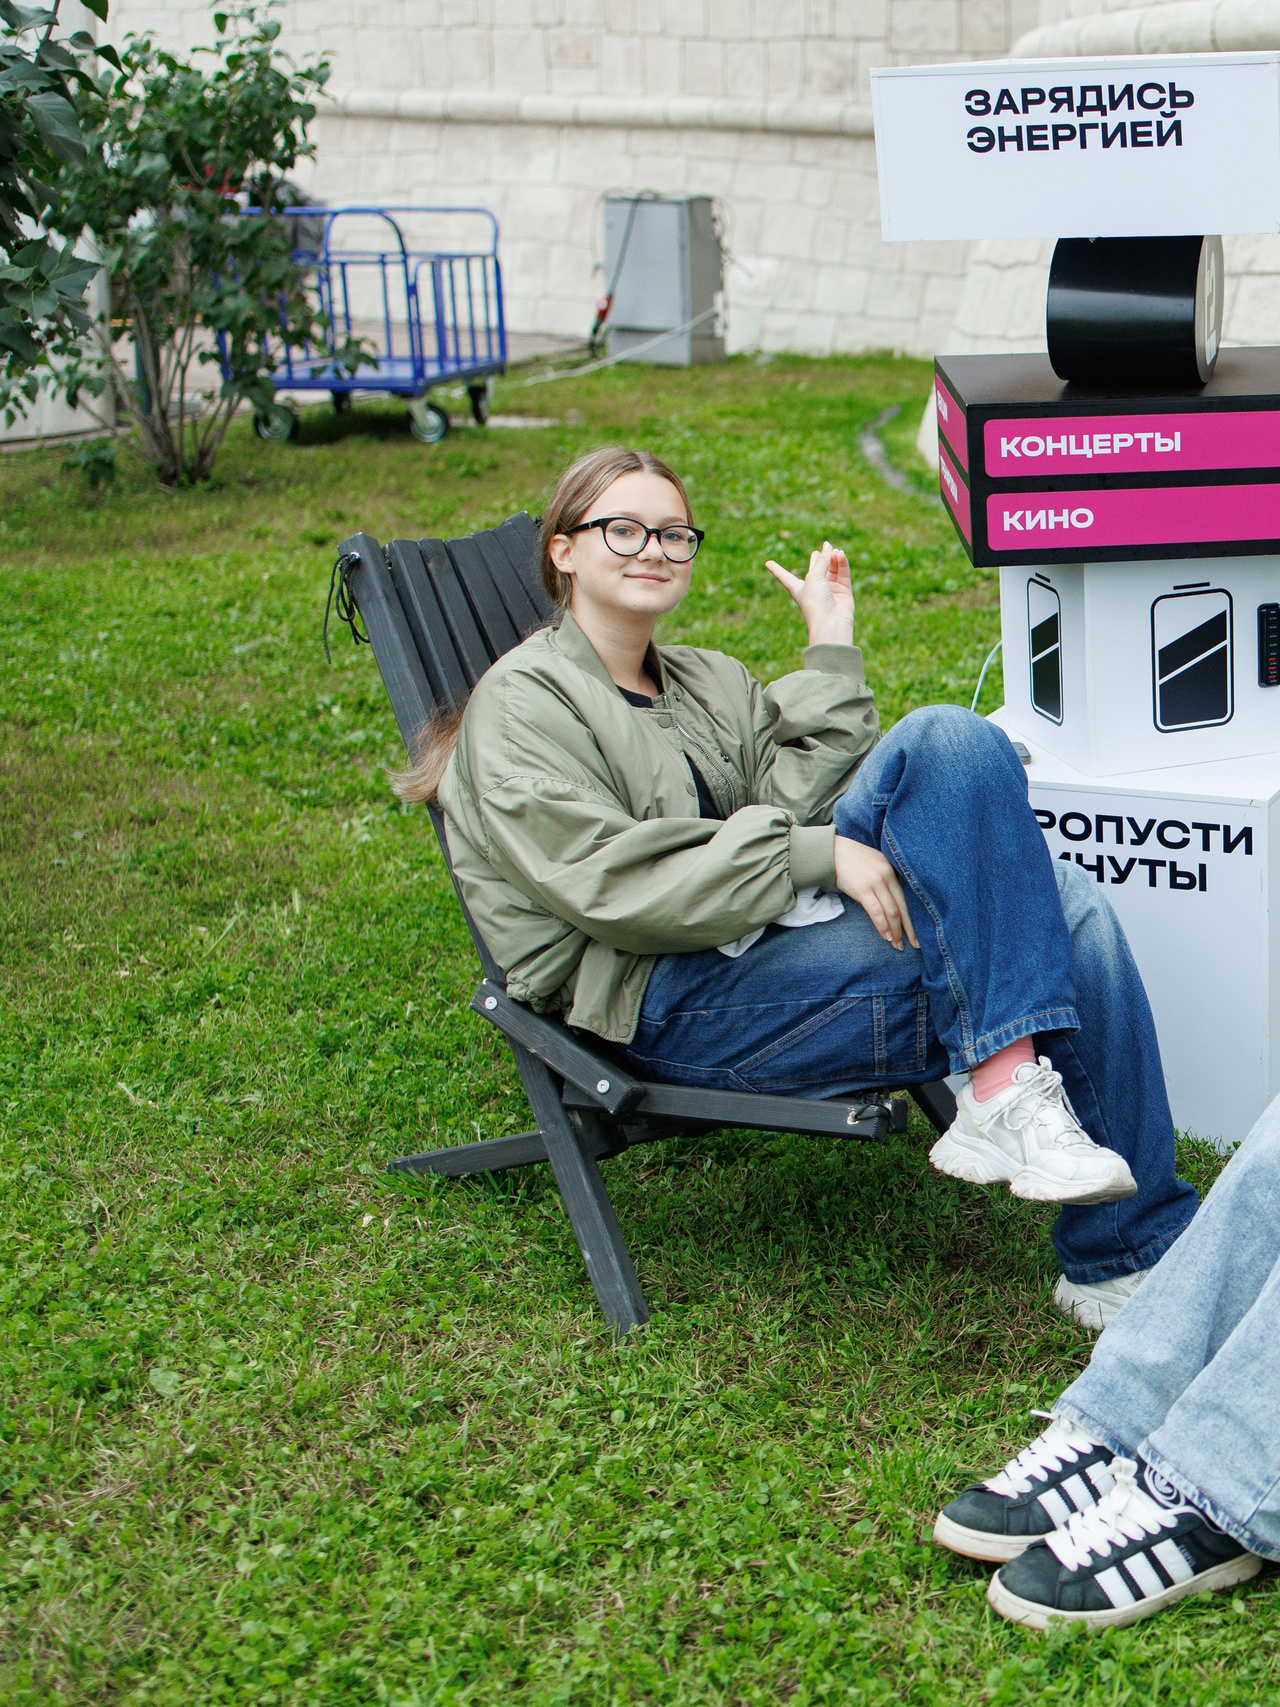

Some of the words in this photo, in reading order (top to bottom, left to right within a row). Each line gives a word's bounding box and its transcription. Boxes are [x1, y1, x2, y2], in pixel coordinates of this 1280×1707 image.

[964, 81, 1195, 118] ЗАРЯДИСЬ
[966, 110, 1183, 154] ЭНЕРГИЕЙ
[1000, 431, 1181, 459] КОНЦЕРТЫ
[1003, 507, 1095, 532] КИНО
[1032, 808, 1253, 856] РОПУСТИ
[1057, 851, 1208, 892] НУТЫ
